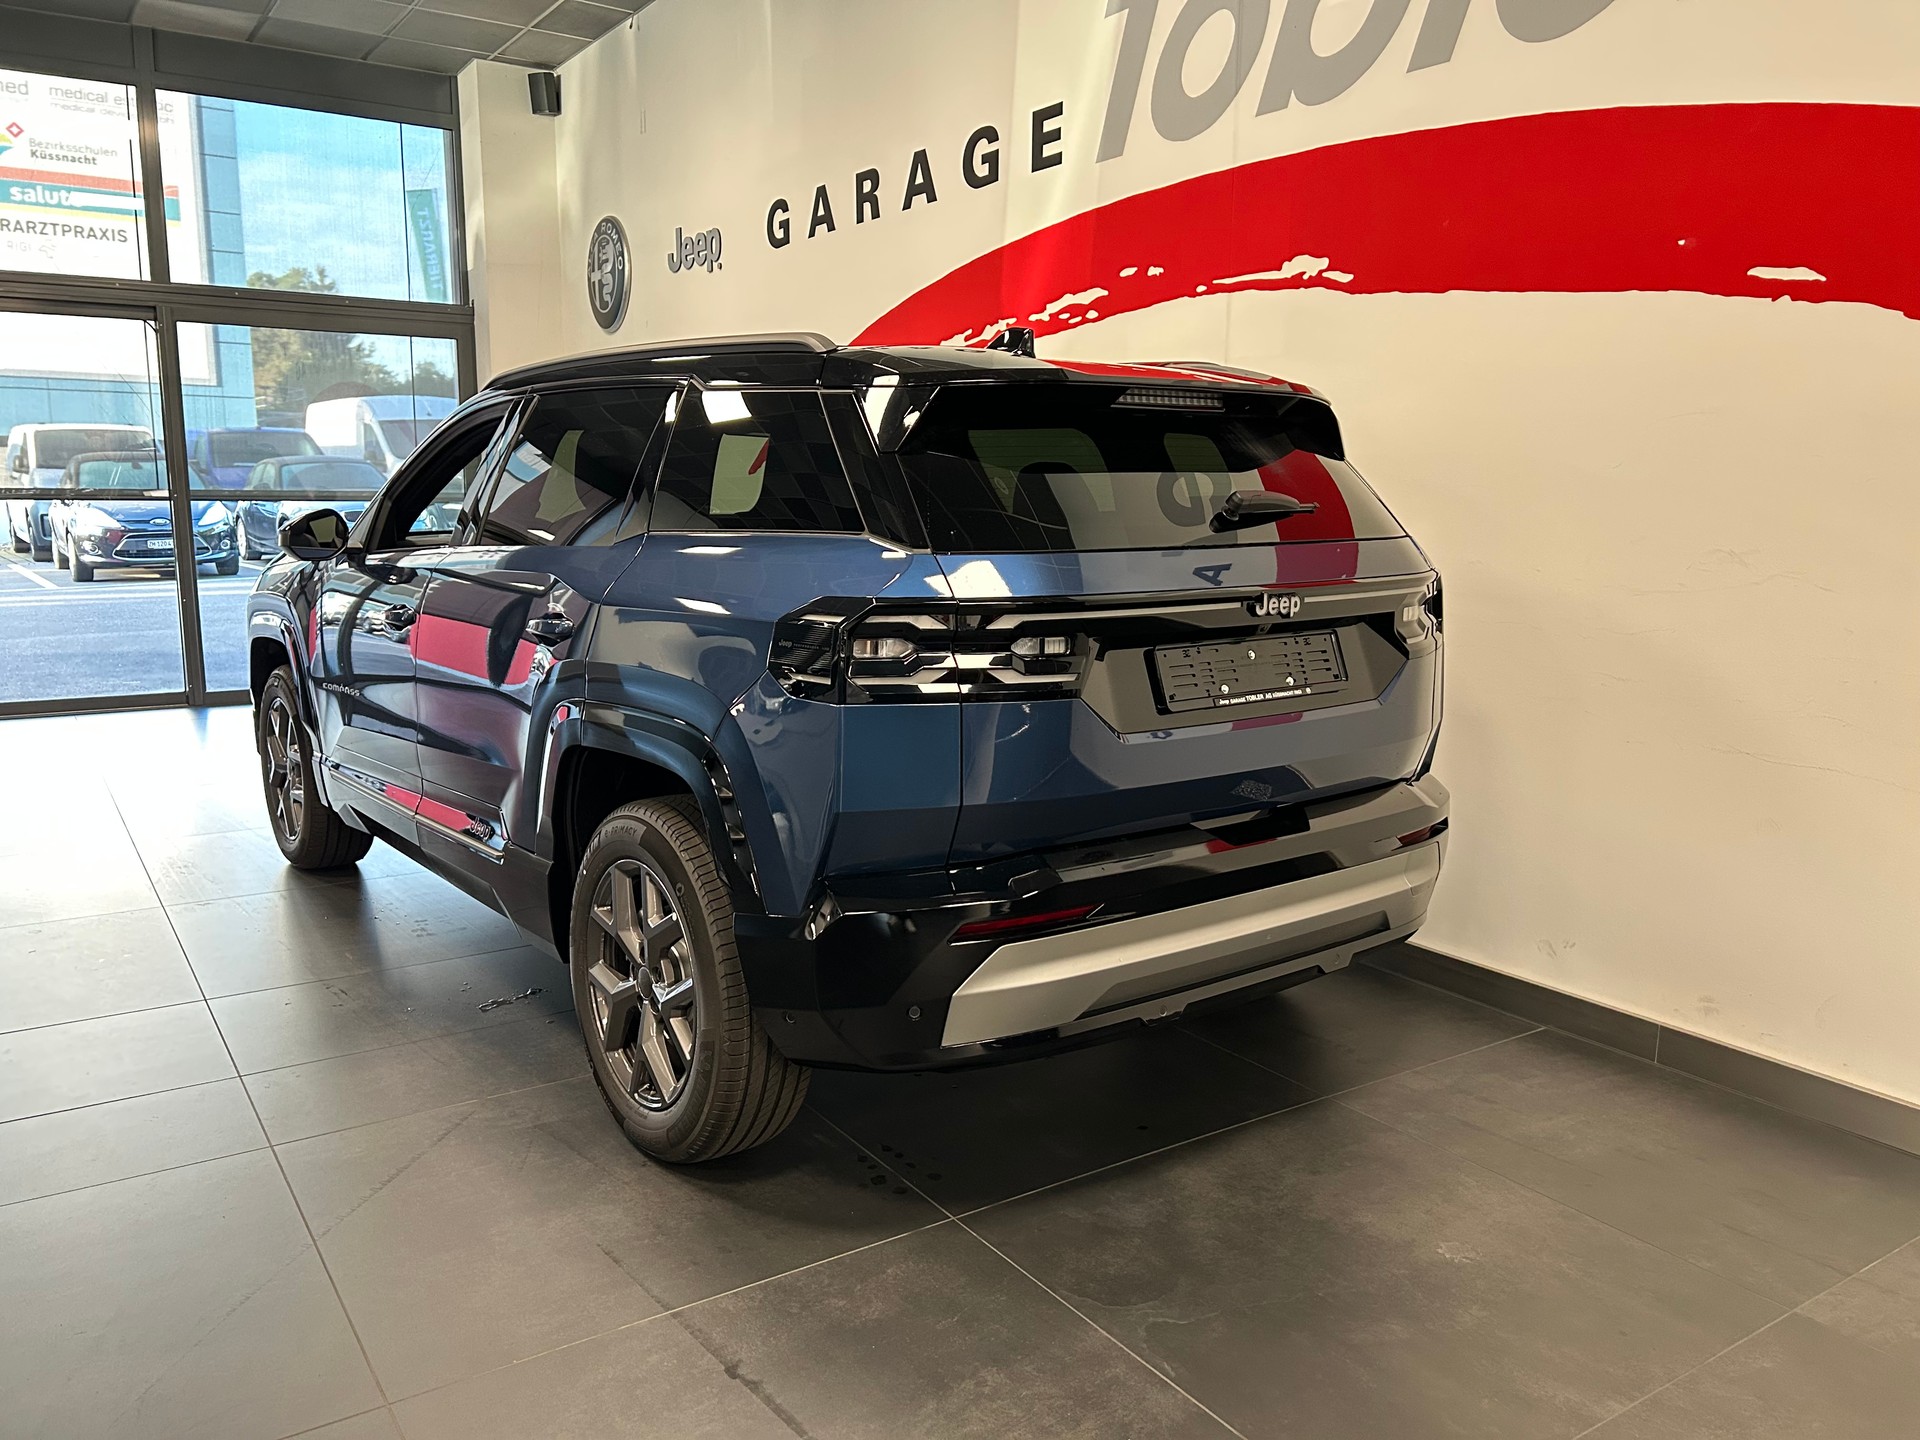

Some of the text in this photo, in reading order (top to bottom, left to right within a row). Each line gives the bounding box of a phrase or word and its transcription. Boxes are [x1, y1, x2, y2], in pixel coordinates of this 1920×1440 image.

[49, 86, 108, 103] medical
[29, 137, 118, 157] Bezirksschulen
[30, 148, 98, 165] Küssnacht
[767, 101, 1063, 249] GARAGE
[0, 218, 128, 243] RARZTPRAXIS
[601, 221, 624, 270] ROMEO
[1255, 591, 1301, 617] Jeep
[1246, 693, 1264, 701] TOBLER
